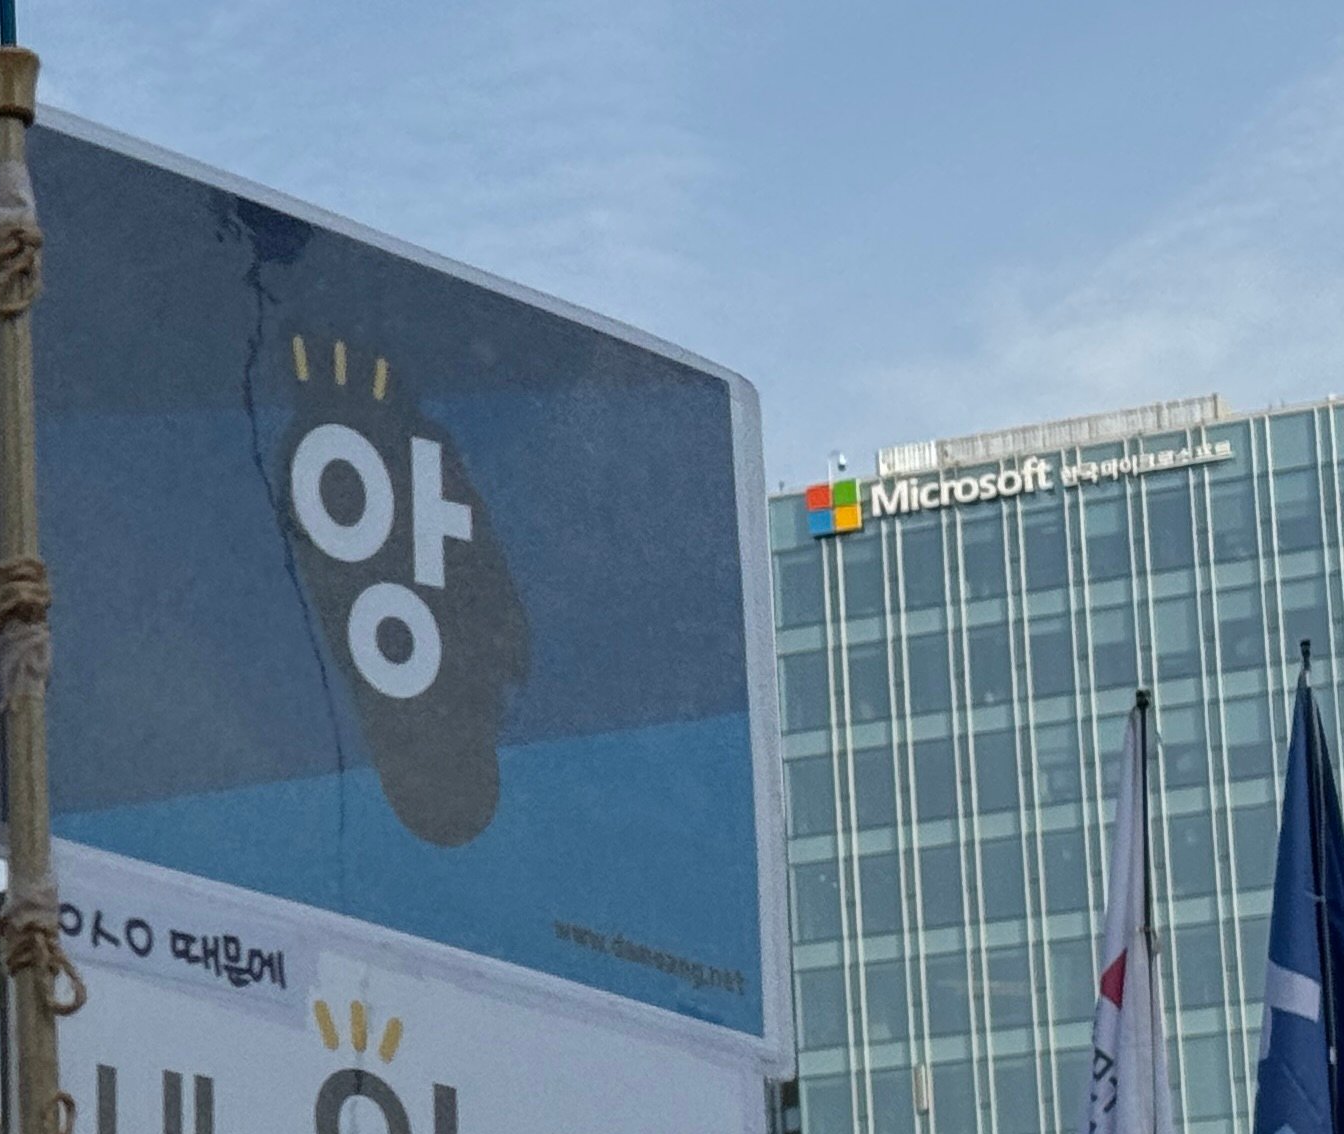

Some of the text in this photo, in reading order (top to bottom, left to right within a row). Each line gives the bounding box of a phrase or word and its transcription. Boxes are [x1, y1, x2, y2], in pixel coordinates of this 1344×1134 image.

[870, 455, 1053, 516] Microsoft
[289, 422, 473, 699] 앙
[169, 929, 288, 991] 때문에
